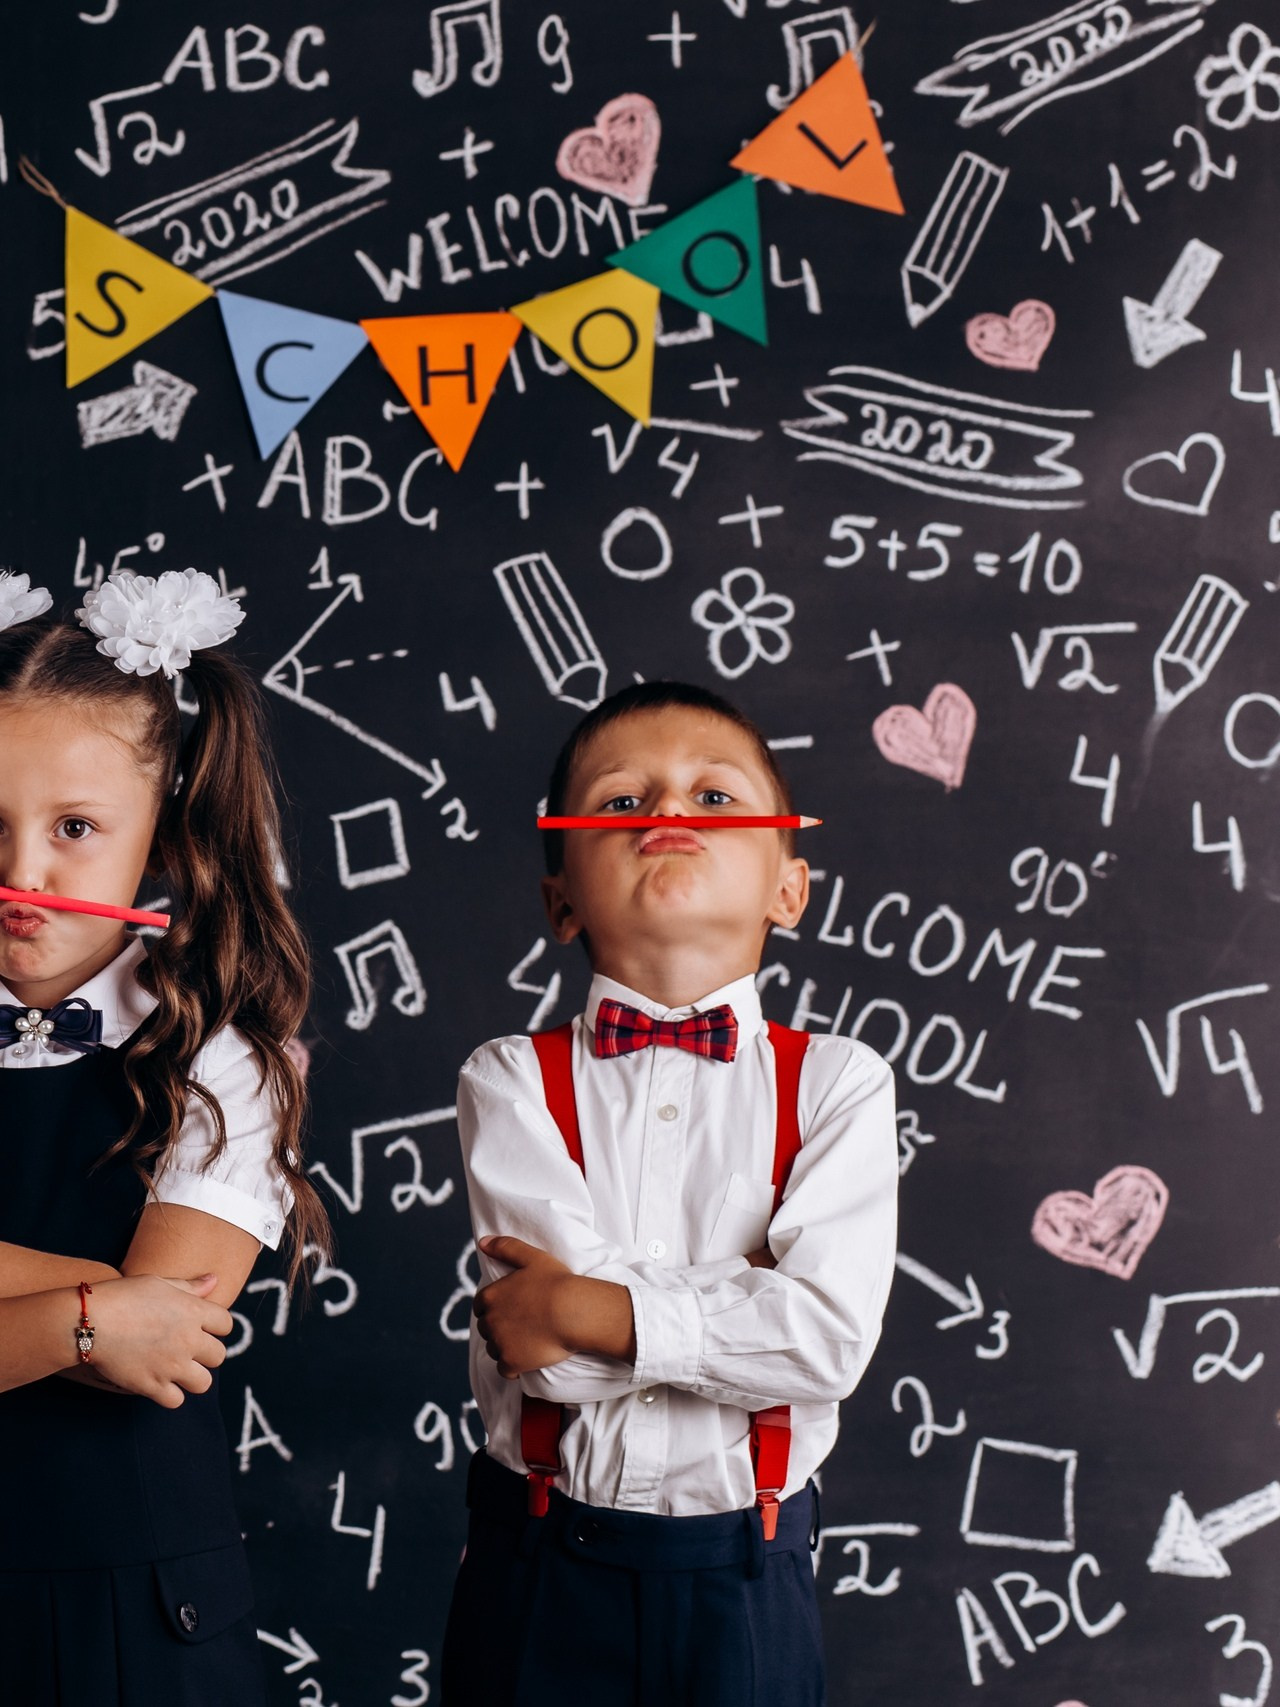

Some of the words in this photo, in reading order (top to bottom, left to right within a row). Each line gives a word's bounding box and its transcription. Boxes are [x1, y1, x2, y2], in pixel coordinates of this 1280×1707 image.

[162, 23, 330, 92] ABC
[162, 178, 301, 268] 2020
[769, 244, 822, 314] 4
[860, 402, 996, 471] 2020
[257, 428, 445, 532] ABC
[438, 671, 497, 731] 4
[440, 797, 479, 842] 2
[1069, 734, 1121, 828] 4
[1191, 800, 1248, 893] 4
[507, 937, 562, 1032] 4
[975, 1310, 1011, 1360] 3
[236, 1386, 292, 1472] A
[891, 1375, 967, 1458] 2
[330, 1471, 386, 1590] 4
[955, 1552, 1127, 1687] ABC
